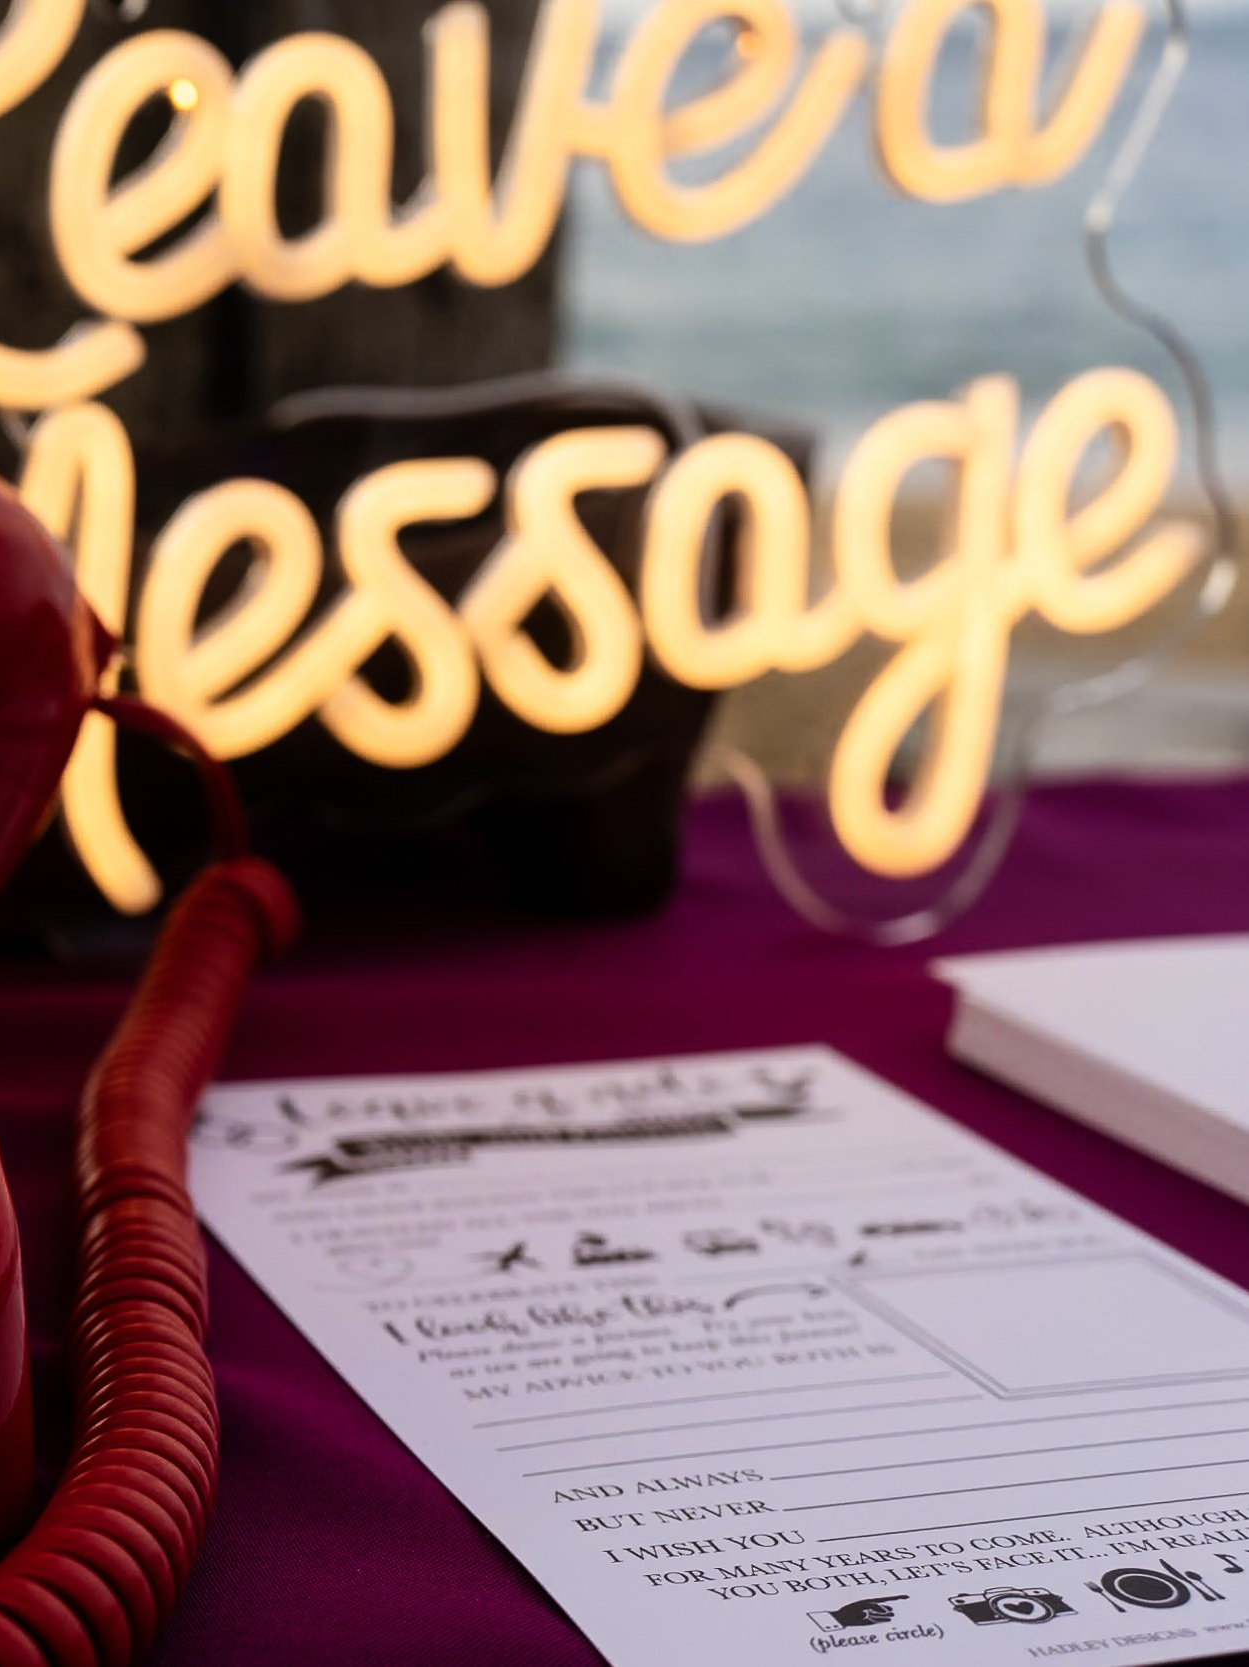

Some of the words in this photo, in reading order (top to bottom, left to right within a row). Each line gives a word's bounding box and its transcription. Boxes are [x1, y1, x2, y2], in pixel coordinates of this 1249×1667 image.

[554, 1484, 624, 1504] AND
[636, 1468, 765, 1495] ALWAYS
[572, 1511, 647, 1533] BUT
[651, 1499, 779, 1525] NEVER
[602, 1549, 625, 1564] I
[623, 1538, 726, 1562] WISH
[723, 1530, 806, 1551] YOU
[643, 1568, 714, 1588] FOR
[714, 1557, 810, 1581] MANY
[814, 1546, 917, 1570] YEARS
[914, 1541, 965, 1558] TO
[969, 1528, 1072, 1552] COME.
[1083, 1509, 1249, 1539] ALTHOUGH
[706, 1580, 780, 1601] YOU
[785, 1571, 888, 1594] BOTH,
[973, 1548, 1055, 1572] FACE
[809, 1633, 880, 1654] (please
[886, 1622, 945, 1643] circle)
[1027, 1637, 1111, 1658] HADLEY
[1111, 1626, 1198, 1648] DESIGNS
